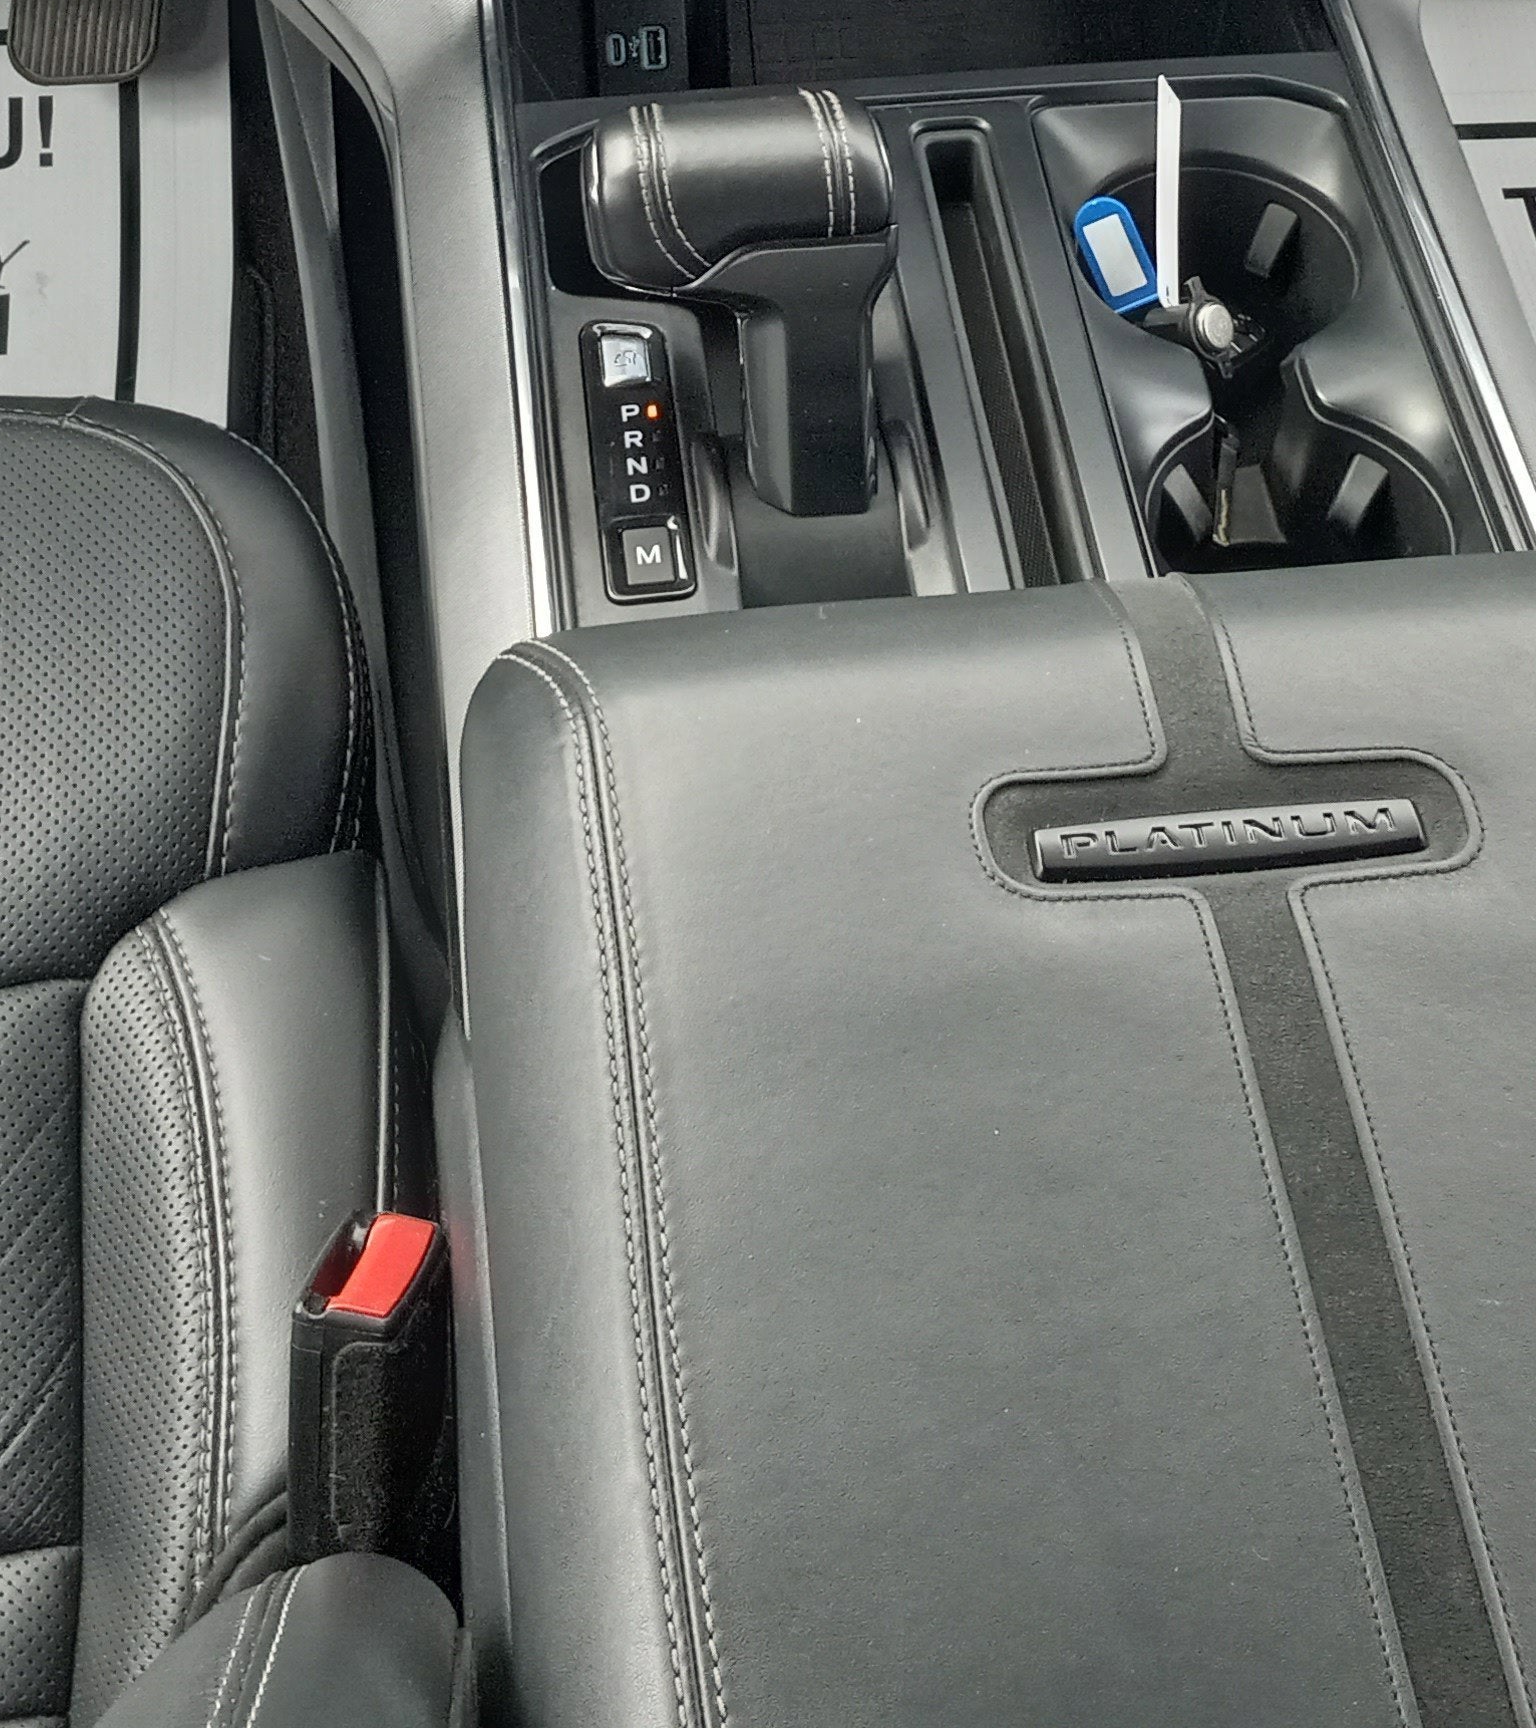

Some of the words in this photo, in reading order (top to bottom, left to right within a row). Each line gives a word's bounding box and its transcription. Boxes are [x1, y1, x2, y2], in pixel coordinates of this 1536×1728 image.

[620, 404, 641, 423] P
[623, 430, 644, 449] R
[626, 456, 649, 476] N
[629, 483, 652, 504] D
[635, 544, 662, 565] M
[1058, 807, 1399, 859] PLATINUM
